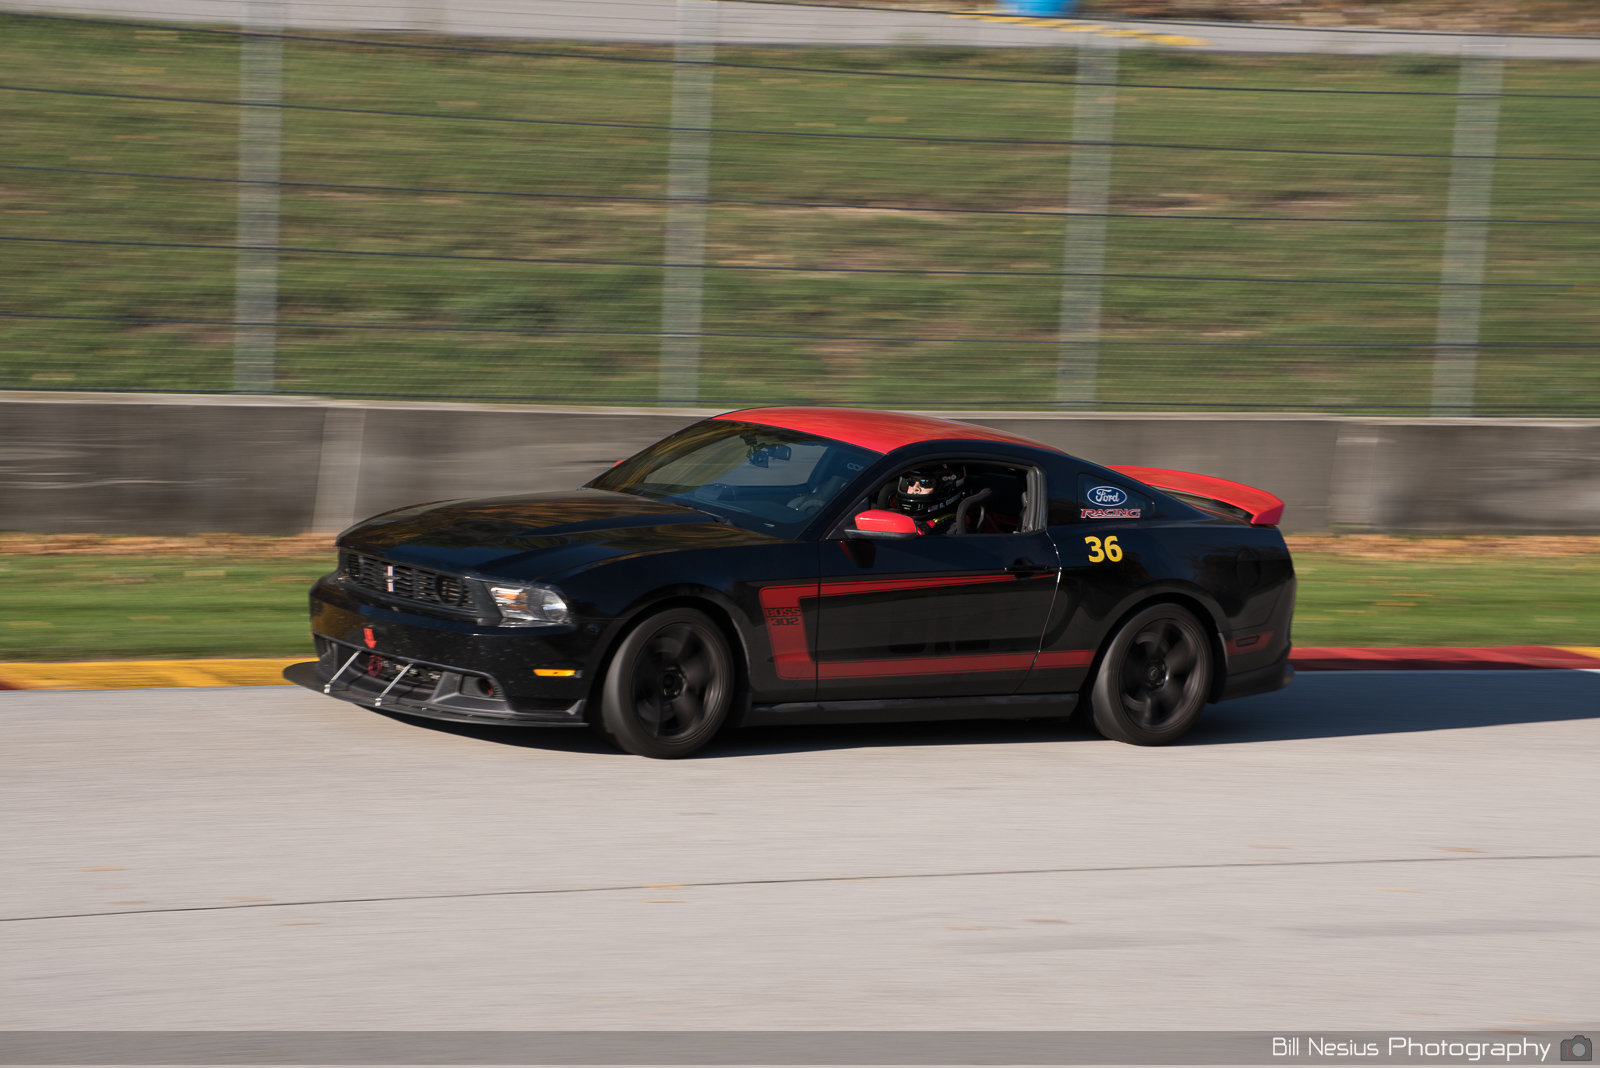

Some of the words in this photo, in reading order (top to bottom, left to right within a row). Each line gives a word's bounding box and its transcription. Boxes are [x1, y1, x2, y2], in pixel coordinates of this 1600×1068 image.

[1095, 488, 1120, 502] Ford
[1080, 508, 1141, 519] RACING
[1084, 535, 1123, 563] 36
[765, 607, 801, 617] BOSS
[770, 617, 800, 626] 302
